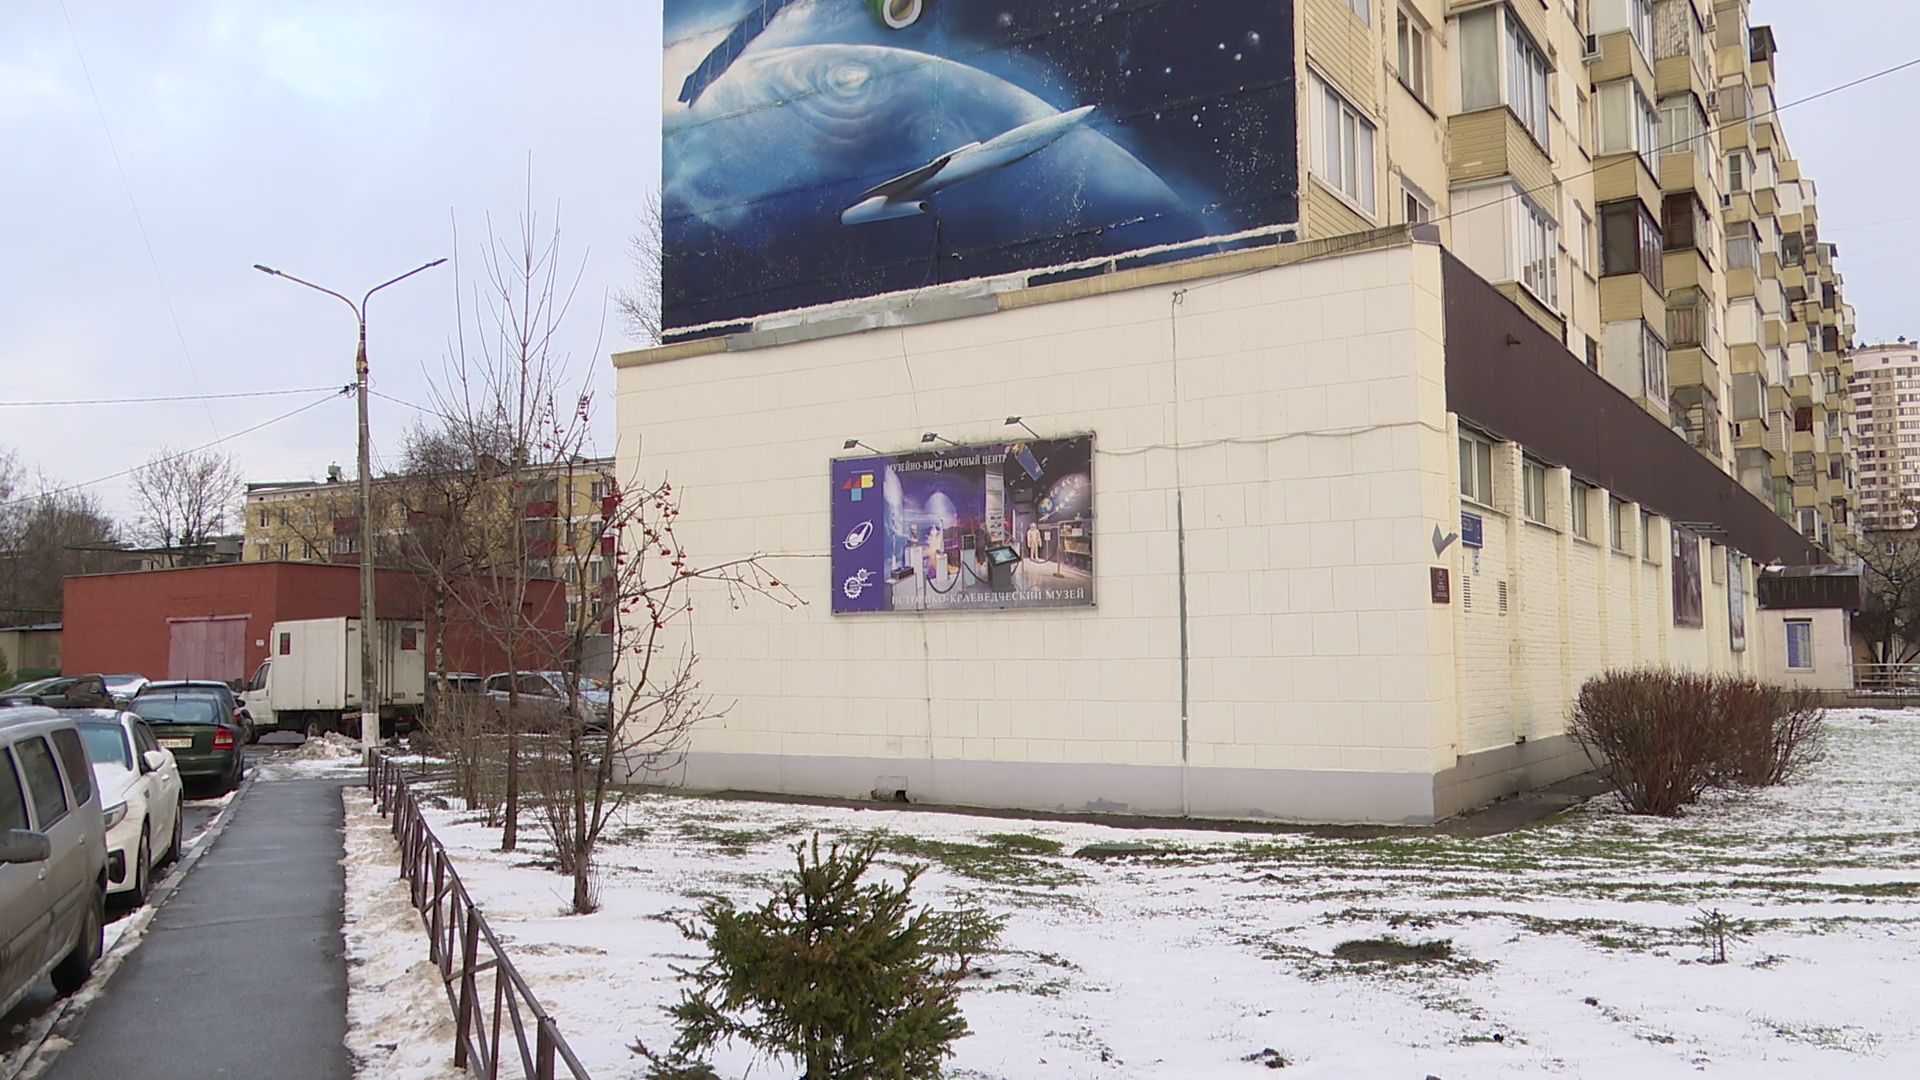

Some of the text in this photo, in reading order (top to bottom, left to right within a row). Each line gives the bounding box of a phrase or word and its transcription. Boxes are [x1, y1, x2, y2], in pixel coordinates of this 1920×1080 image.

[887, 453, 1007, 472] МУЗЕЙНО-ВЫСТАВОЧНЫЙ ЦЕНТР
[1046, 587, 1085, 600] МУЗЕЙ
